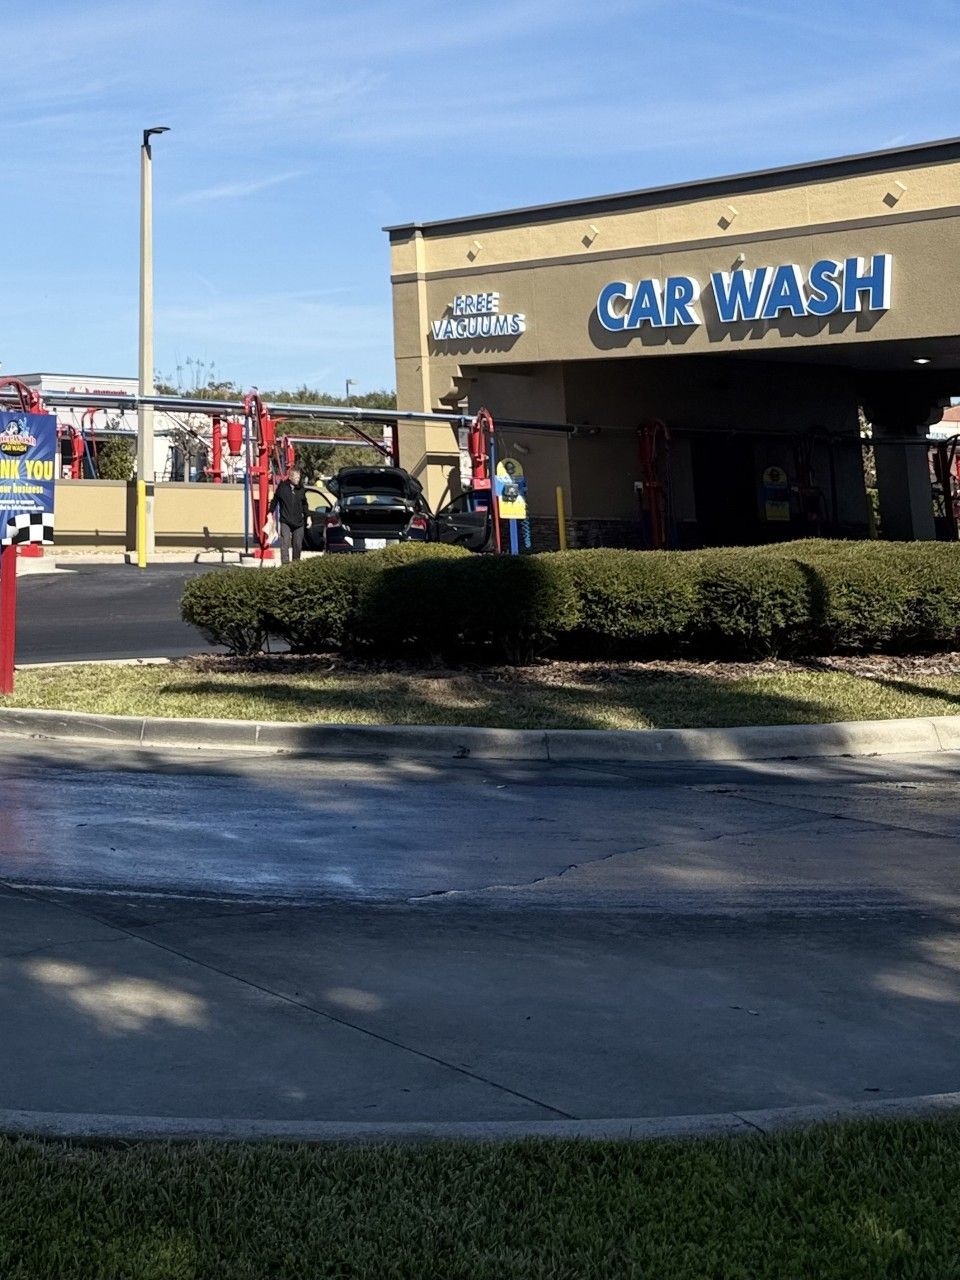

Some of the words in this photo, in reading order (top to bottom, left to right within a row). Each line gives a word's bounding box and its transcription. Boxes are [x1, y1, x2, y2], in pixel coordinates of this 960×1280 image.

[453, 291, 500, 316] FREE
[596, 276, 702, 332] CAR
[709, 253, 892, 323] WASH
[431, 313, 527, 340] VACUUMS
[25, 460, 54, 481] YOU
[12, 482, 44, 494] business
